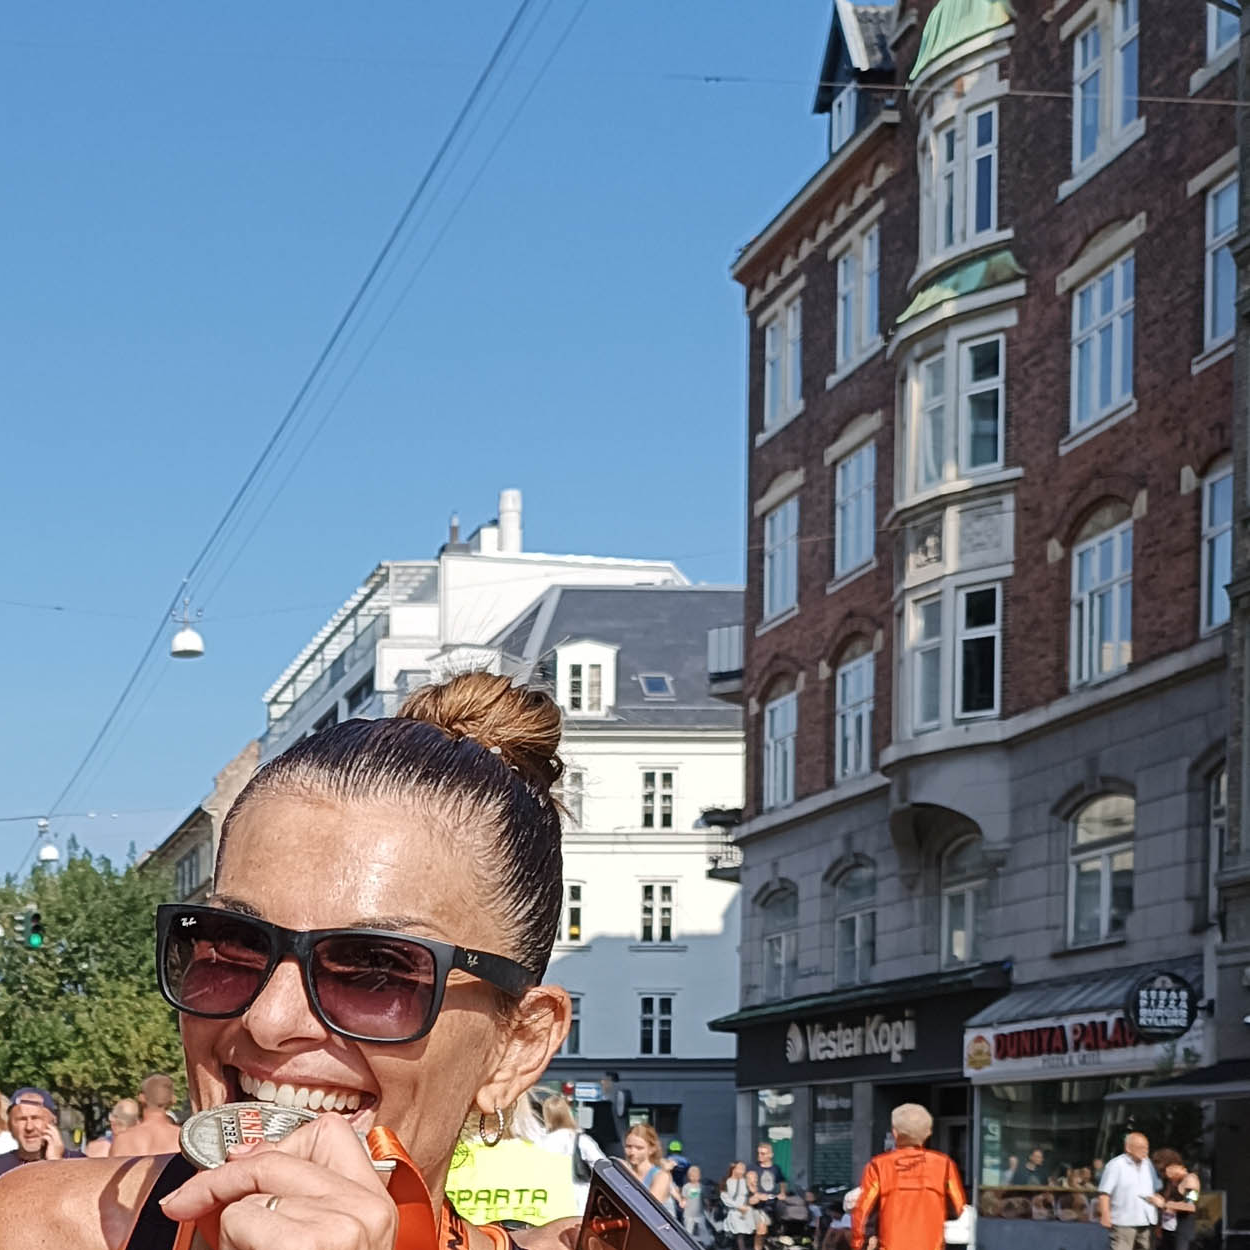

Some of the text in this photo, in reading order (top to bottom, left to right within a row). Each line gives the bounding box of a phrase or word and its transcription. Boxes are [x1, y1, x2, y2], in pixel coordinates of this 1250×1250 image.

[806, 1008, 916, 1063] Vester Kopi
[994, 1025, 1067, 1060] DUNIYA
[238, 1108, 264, 1146] FINIS
